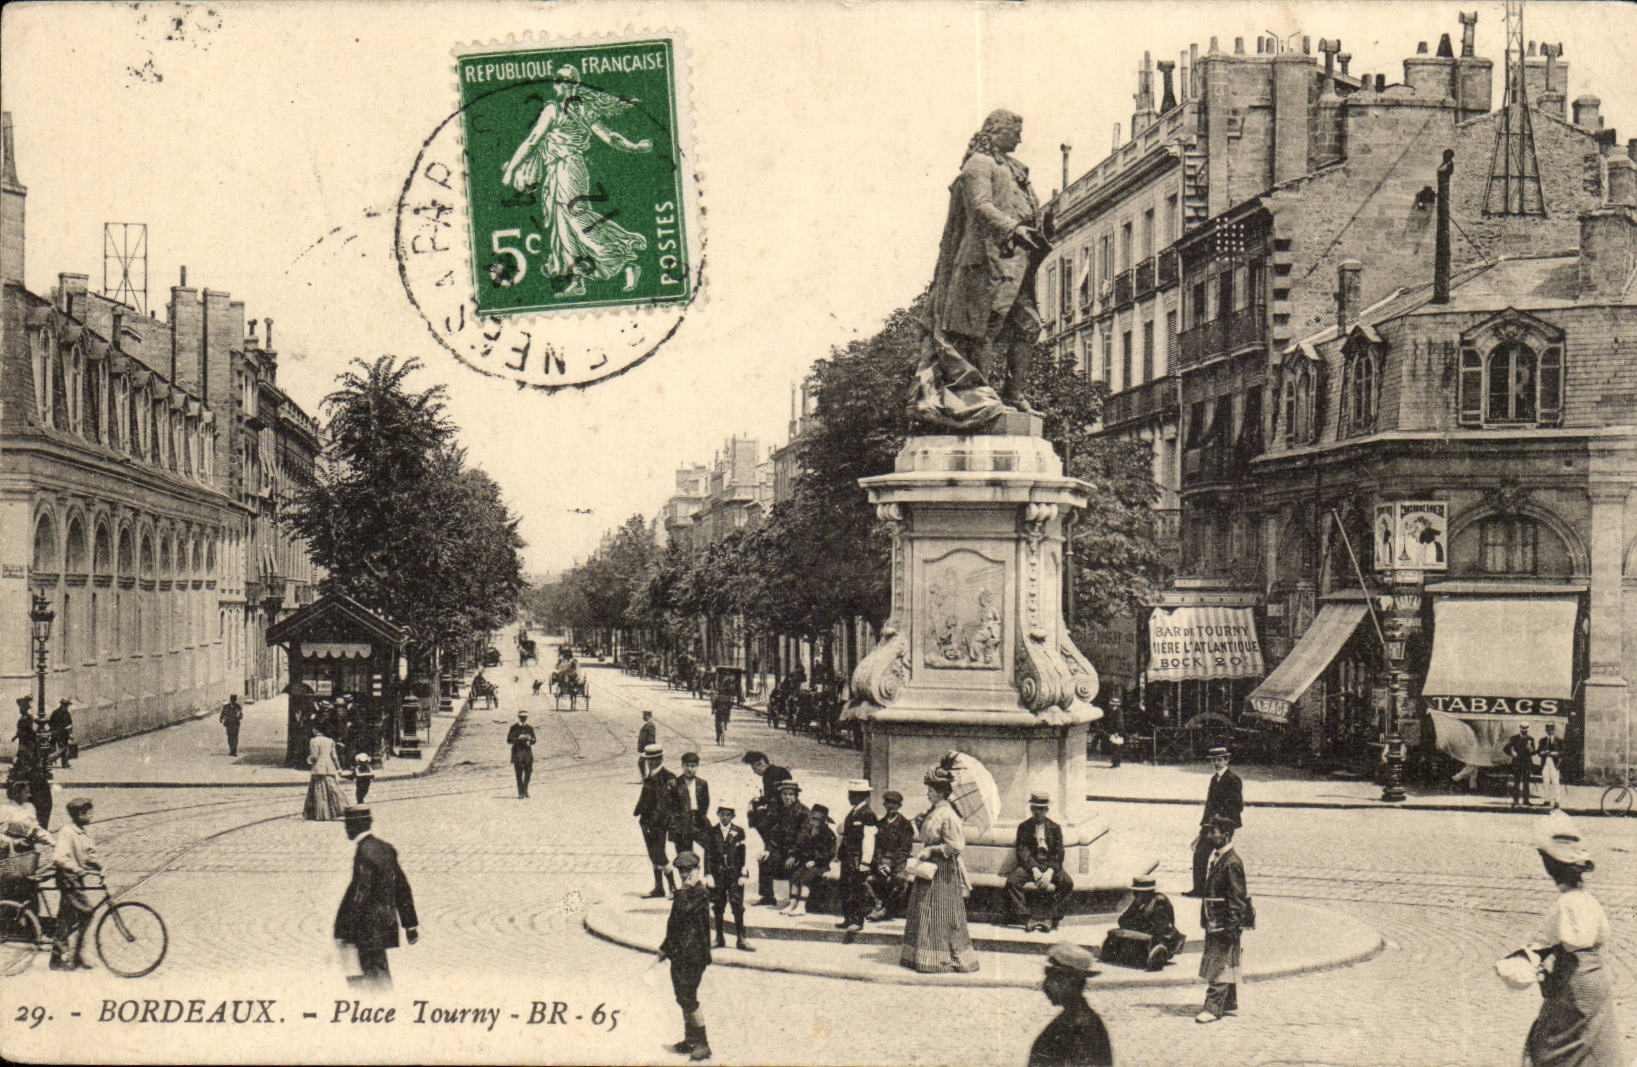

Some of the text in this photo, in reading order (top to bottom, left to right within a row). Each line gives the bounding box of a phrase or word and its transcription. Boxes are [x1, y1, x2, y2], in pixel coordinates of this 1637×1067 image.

[581, 51, 665, 75] FRANÇAISE
[655, 201, 679, 285] POSTES
[1156, 626, 1181, 637] BAR
[1197, 625, 1250, 637] TOURNY
[1160, 657, 1203, 668] BOCK
[1432, 697, 1559, 715] TABACS
